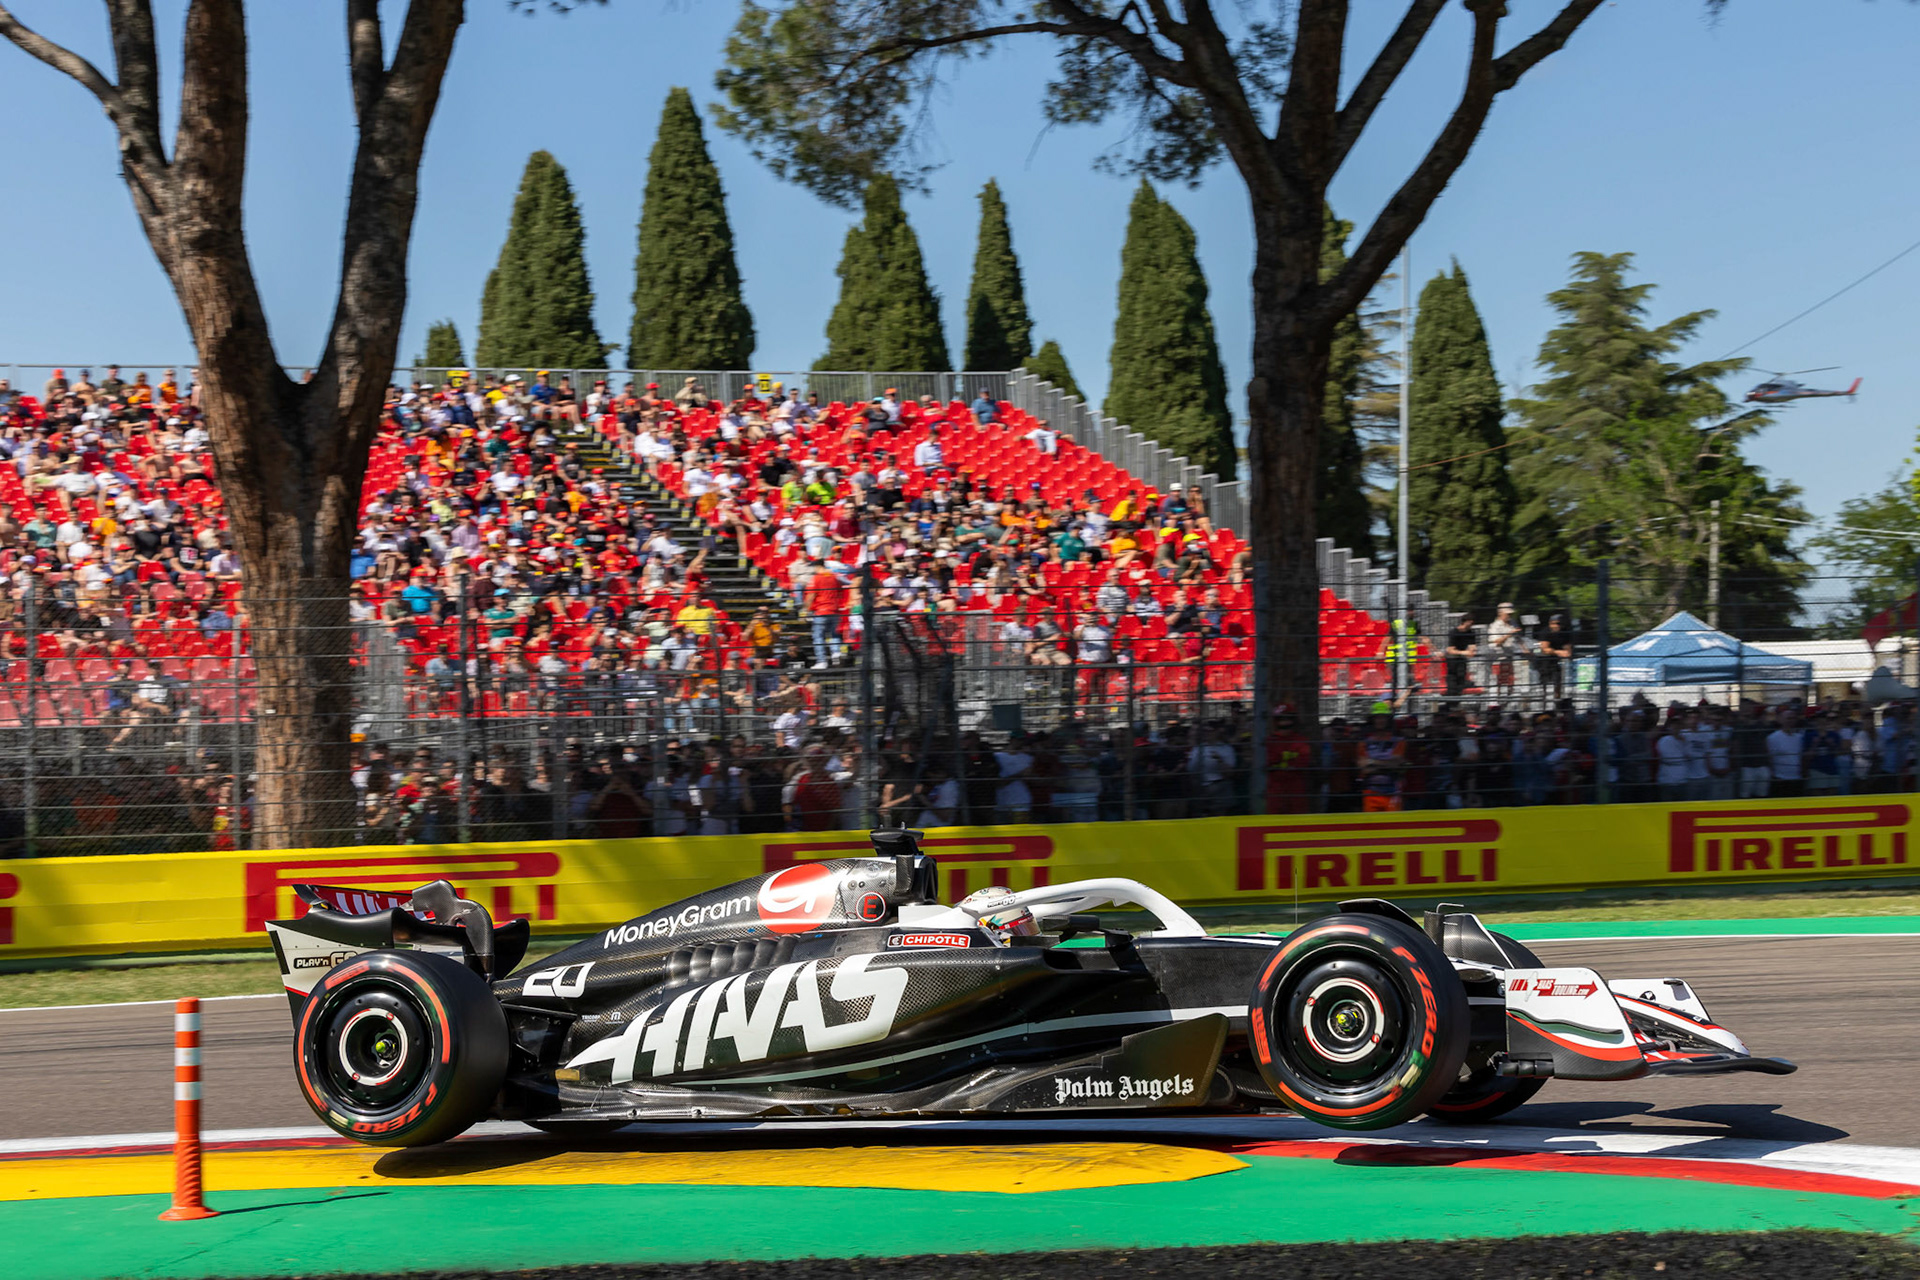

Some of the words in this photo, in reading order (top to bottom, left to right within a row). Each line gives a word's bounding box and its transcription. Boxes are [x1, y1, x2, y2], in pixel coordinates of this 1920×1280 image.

[1236, 818, 1503, 891] PIRELLI
[1668, 804, 1911, 873] PIRELLI
[603, 894, 751, 949] MoneyGram
[862, 894, 878, 919] E
[905, 936, 967, 947] CHIPOTLE
[522, 961, 596, 998] 20
[564, 953, 909, 1086] HAAS
[1054, 1076, 1115, 1104] Palm
[1118, 1073, 1195, 1101] Angels
[351, 1101, 423, 1133] ZERO
